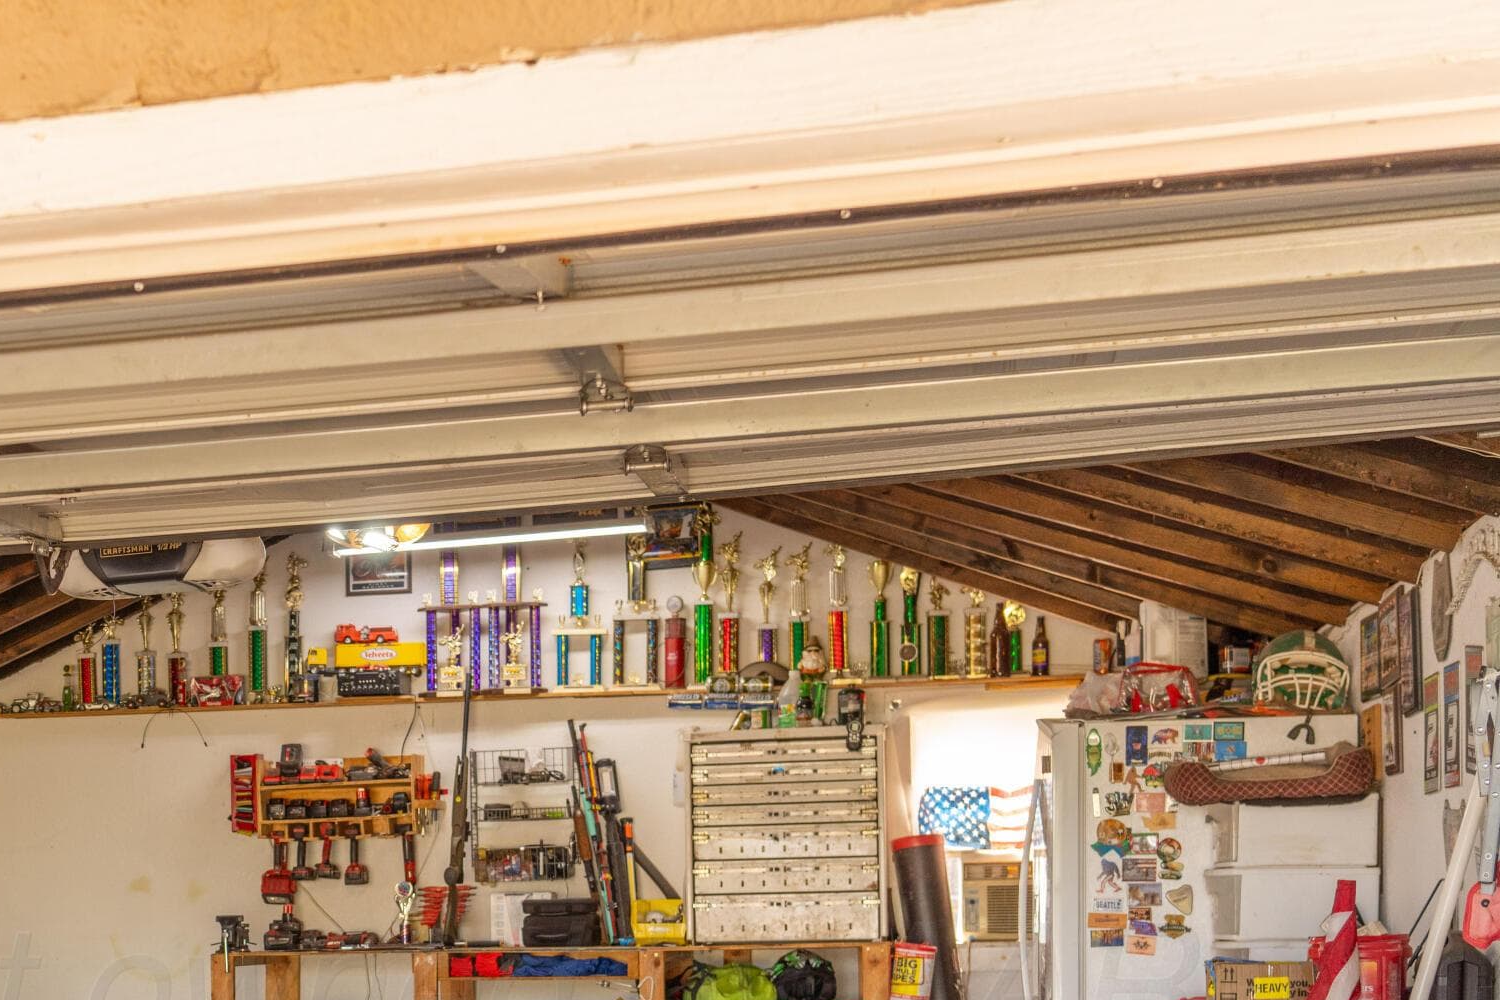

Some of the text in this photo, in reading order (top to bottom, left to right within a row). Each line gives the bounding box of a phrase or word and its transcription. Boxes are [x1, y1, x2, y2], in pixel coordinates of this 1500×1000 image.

[102, 544, 150, 556] CRAFTSMAN
[897, 957, 918, 969] BIG
[1255, 983, 1289, 994] HEAVY
